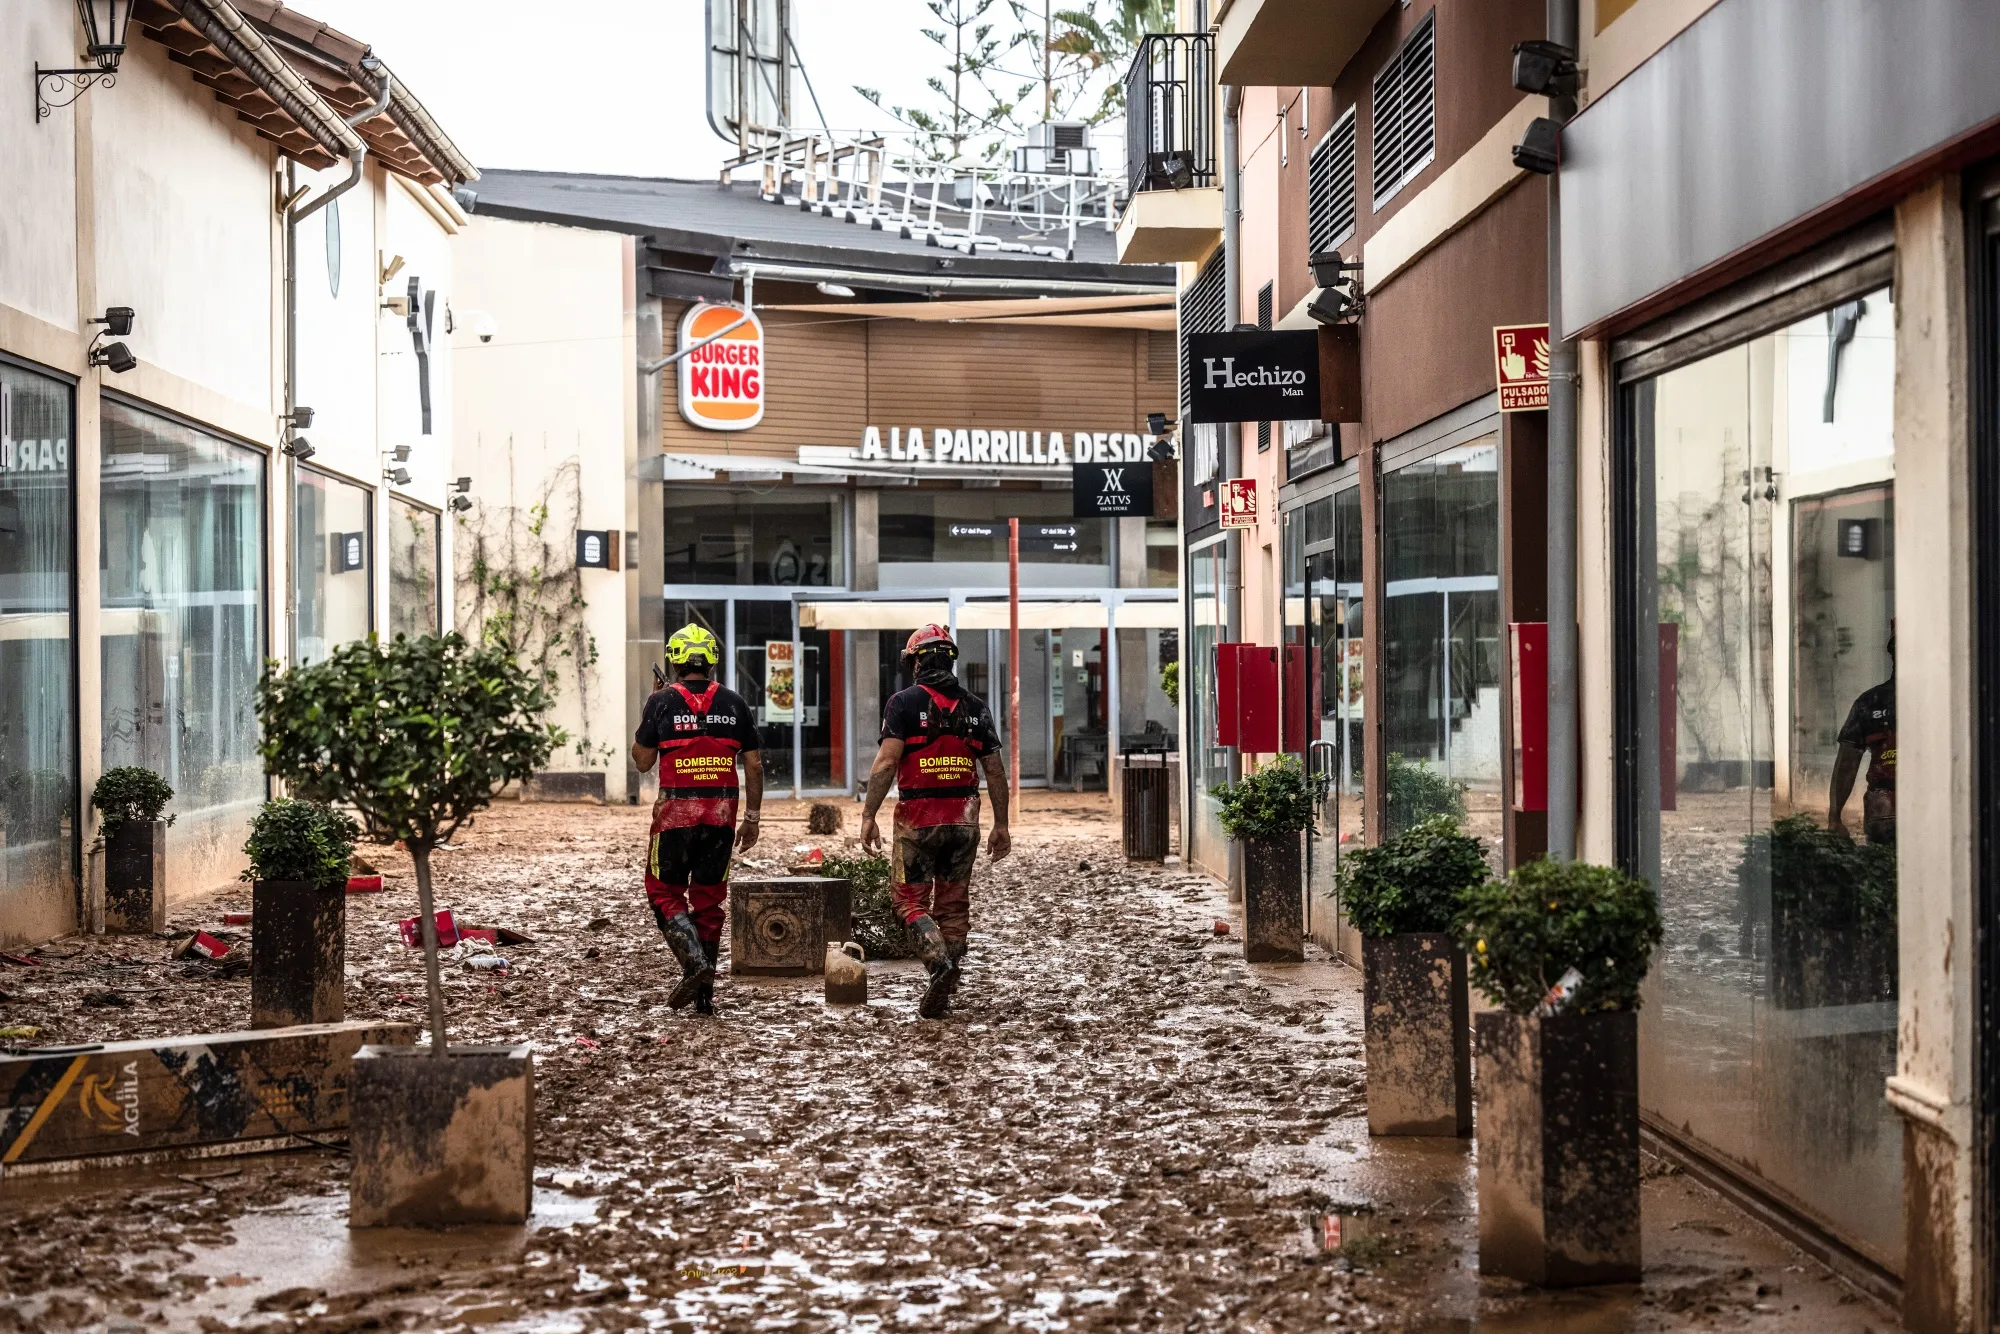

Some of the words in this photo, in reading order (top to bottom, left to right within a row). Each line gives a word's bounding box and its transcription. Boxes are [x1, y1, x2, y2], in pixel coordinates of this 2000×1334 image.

[690, 342, 759, 366] BURGER
[1203, 357, 1306, 388] Hechizo
[691, 366, 760, 399] KING
[1282, 388, 1304, 397] Man
[1503, 398, 1516, 407] DE
[1517, 396, 1549, 406] ALARM
[862, 426, 881, 459] A
[889, 427, 926, 461] LA
[933, 428, 1066, 464] PARRILLA
[673, 714, 736, 725] BOMEROS
[675, 756, 733, 768] BOMBEROS
[919, 756, 973, 768] BOMBEROS
